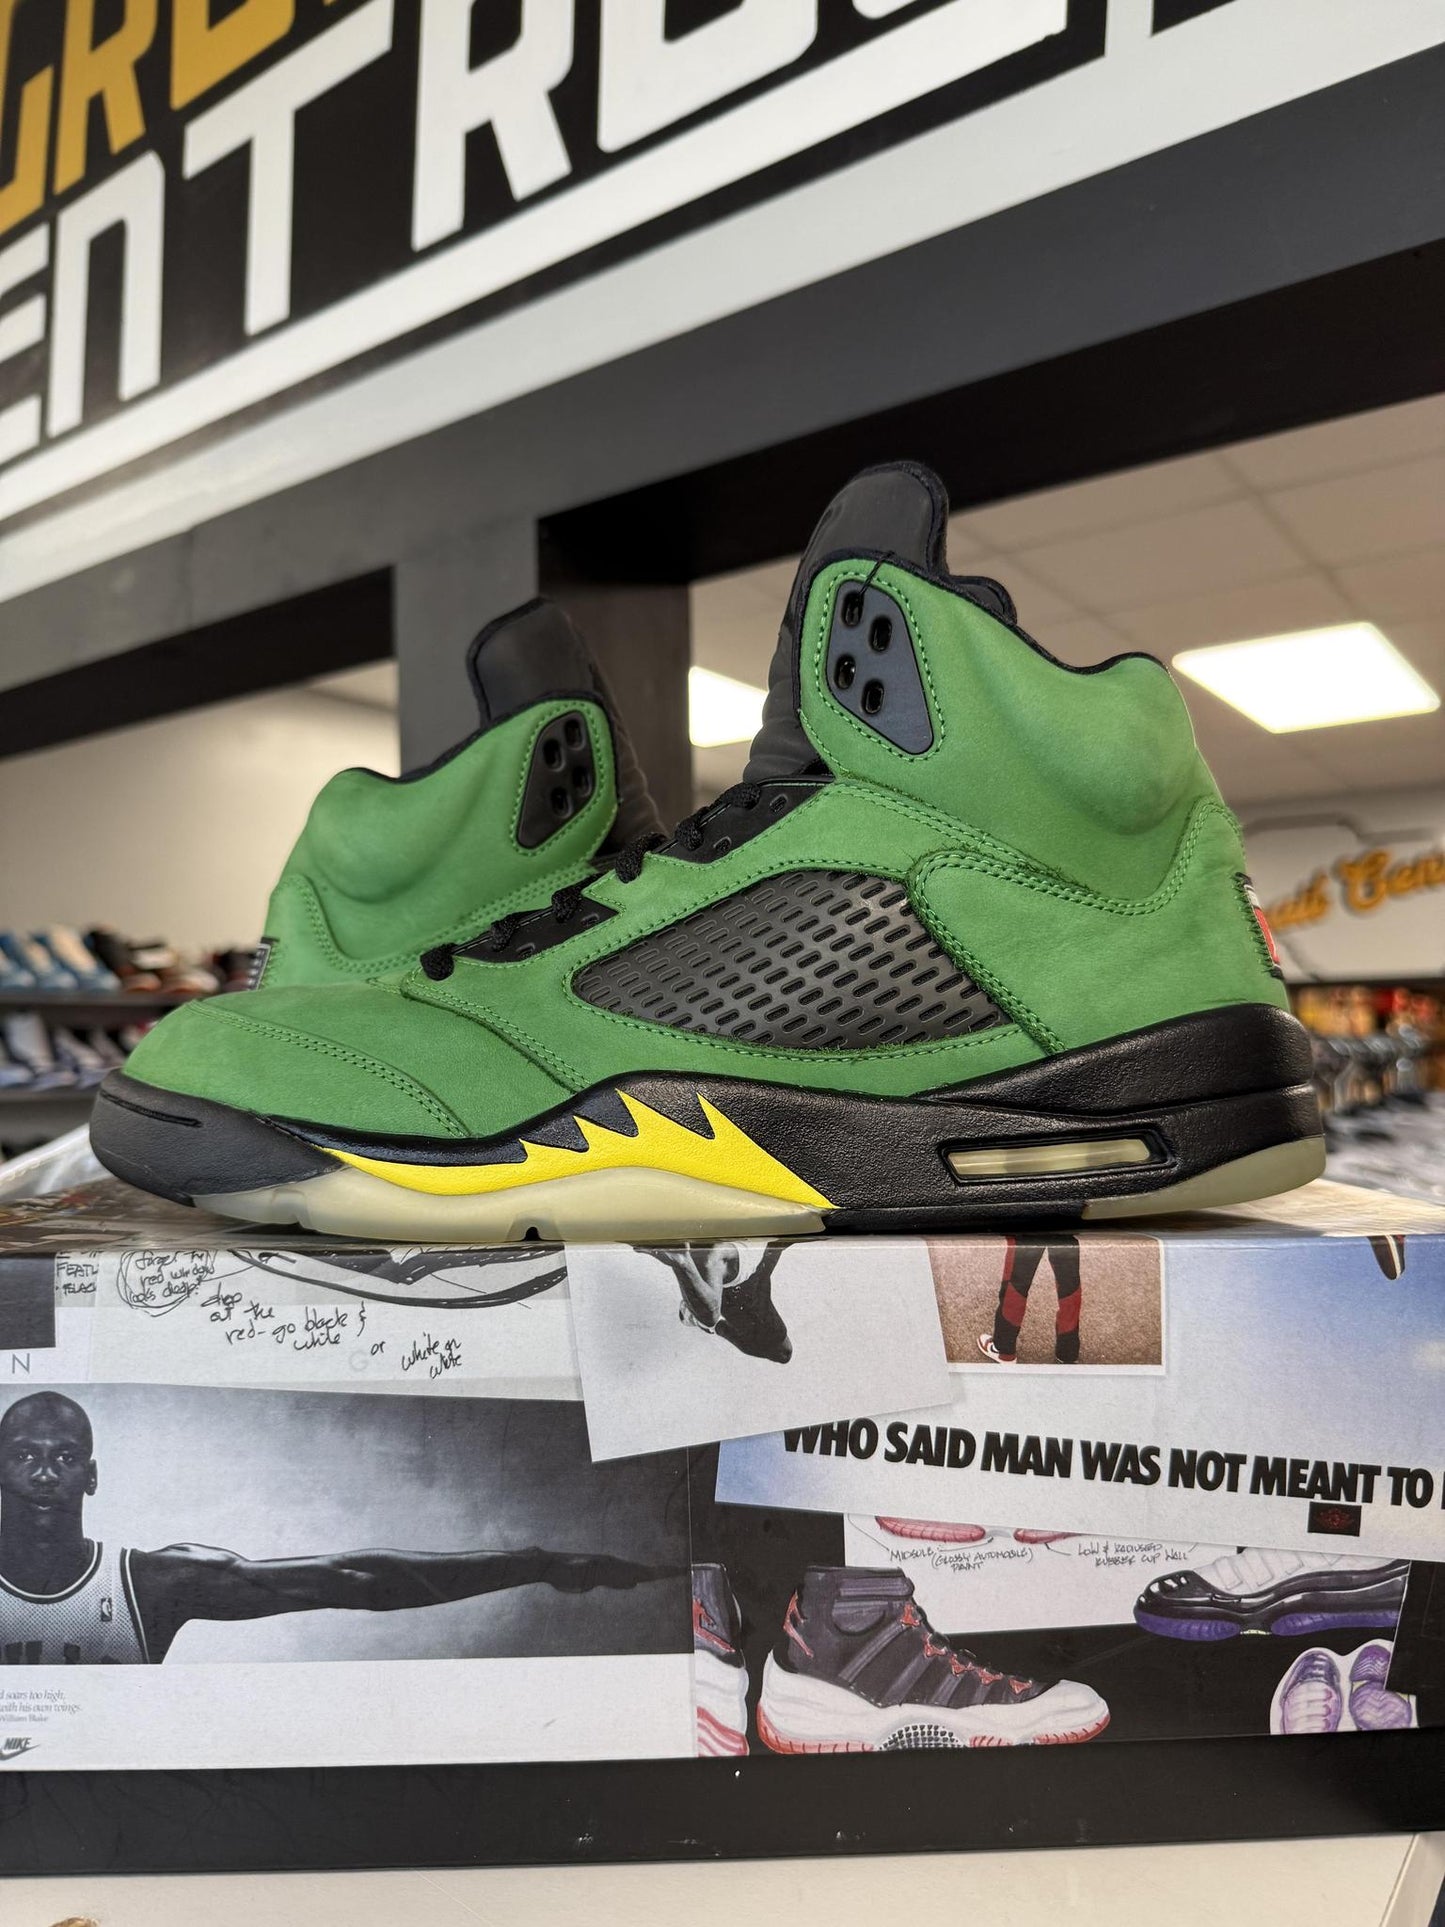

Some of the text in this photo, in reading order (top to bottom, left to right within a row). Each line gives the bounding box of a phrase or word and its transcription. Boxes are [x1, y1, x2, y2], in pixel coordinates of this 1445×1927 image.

[272, 1323, 296, 1343] go
[305, 1306, 348, 1330] black
[294, 1331, 340, 1350] white
[371, 1341, 386, 1355] or
[402, 1332, 439, 1371] white
[784, 1417, 879, 1460] WHO
[884, 1421, 977, 1469] SAID
[980, 1431, 1073, 1478] MAN
[1080, 1440, 1161, 1486] WAS
[1168, 1448, 1247, 1492] NOT
[1249, 1455, 1382, 1503] MEANT
[1387, 1466, 1434, 1508] TO
[1141, 1553, 1161, 1564] CUP
[4, 1737, 32, 1750] NIKE
